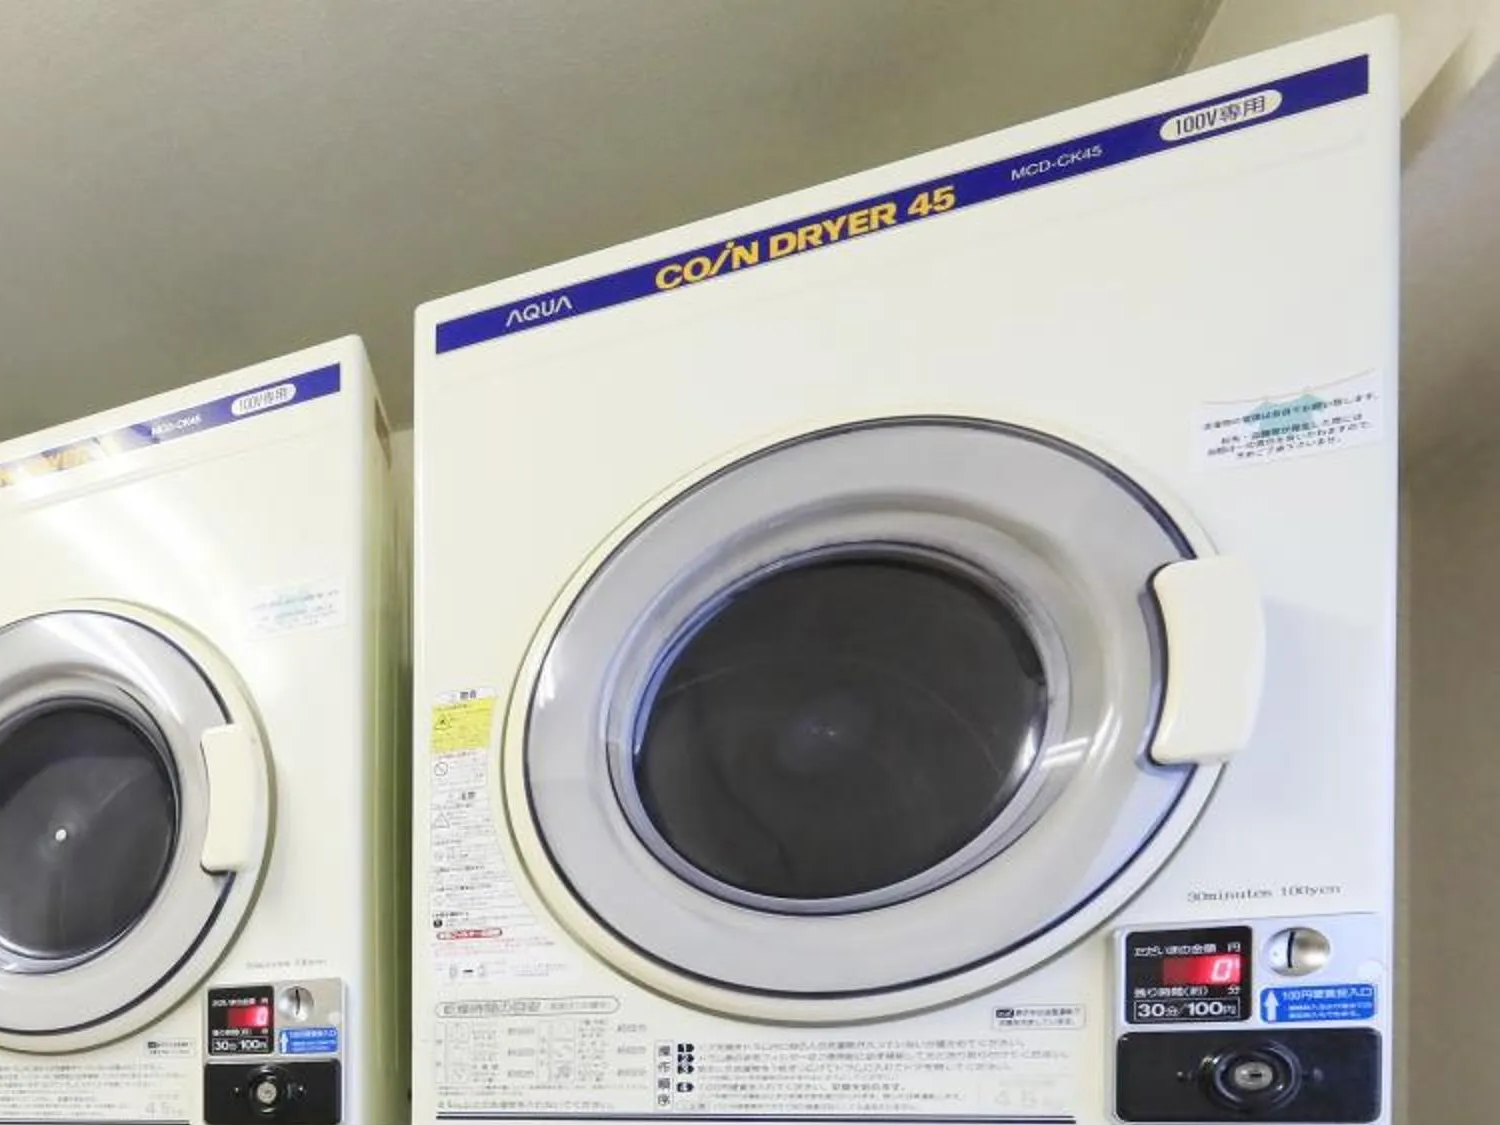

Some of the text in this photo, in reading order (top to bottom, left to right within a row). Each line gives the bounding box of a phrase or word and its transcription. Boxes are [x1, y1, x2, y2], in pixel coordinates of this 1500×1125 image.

[505, 295, 573, 327] AQUA
[769, 203, 897, 260] DRYER
[908, 185, 956, 217] 45
[1011, 144, 1103, 181] MCD-CK45
